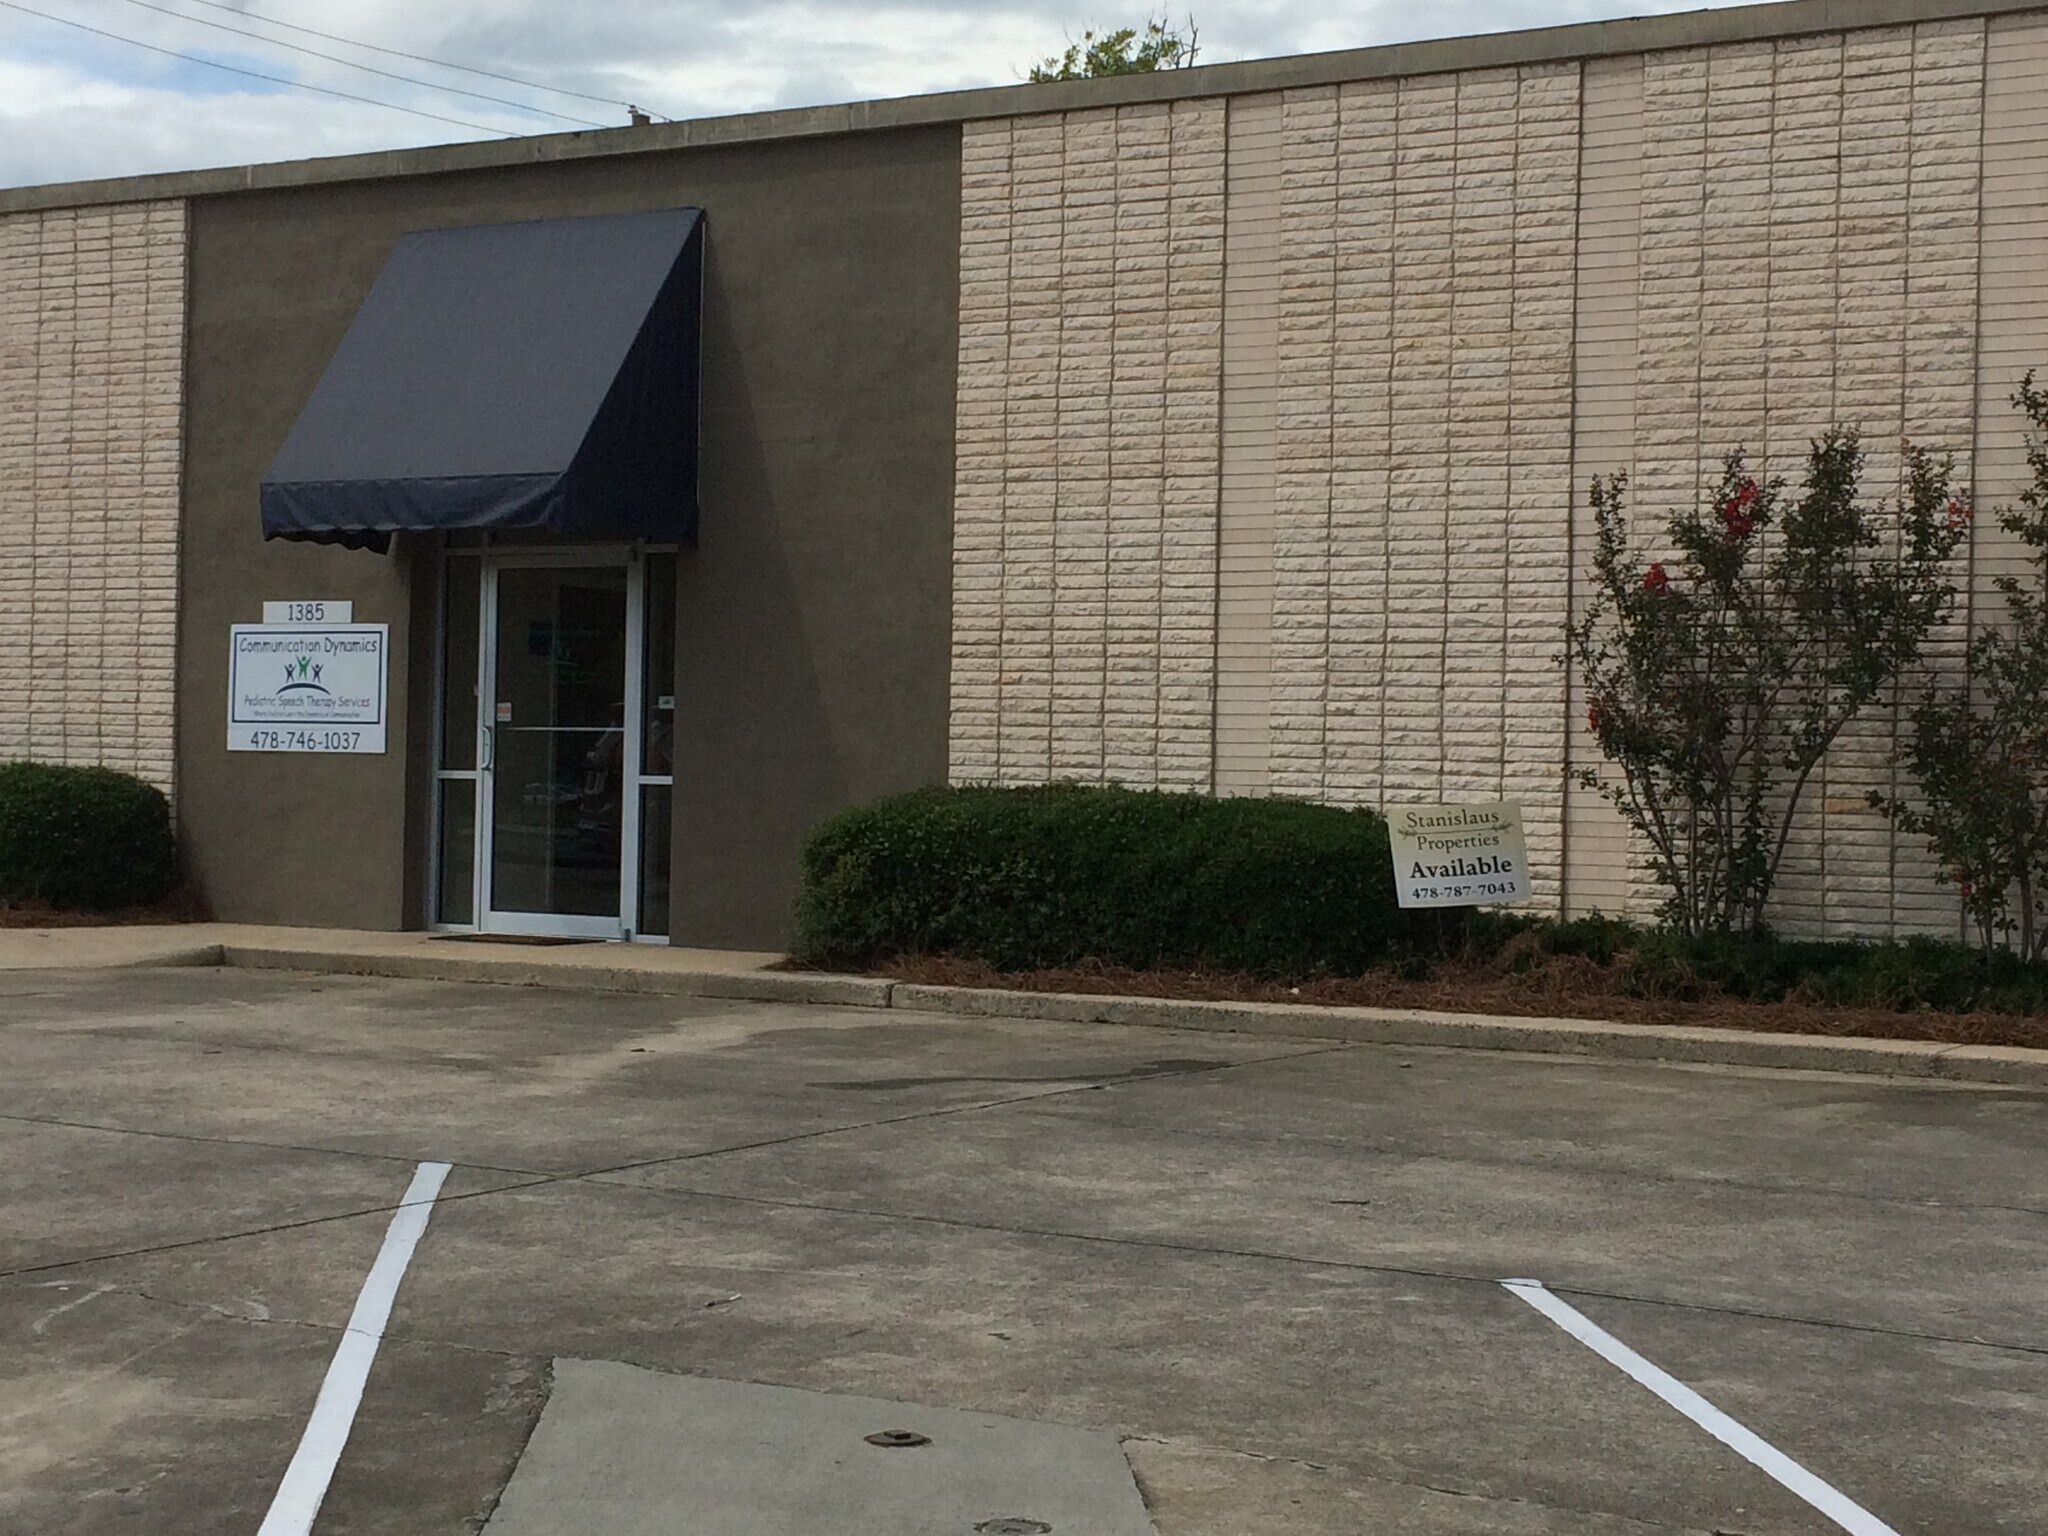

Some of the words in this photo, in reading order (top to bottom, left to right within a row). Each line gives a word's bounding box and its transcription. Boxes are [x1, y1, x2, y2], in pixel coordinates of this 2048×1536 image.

[288, 603, 324, 621] 1385
[240, 638, 320, 653] Communication
[324, 637, 377, 656] Dynamics
[279, 695, 304, 710] Speech
[306, 695, 336, 711] Therapy
[339, 696, 370, 708] Services
[250, 731, 360, 750] 478-746-1037
[1406, 809, 1499, 828] Stanislaus
[1417, 834, 1500, 854] Properties
[1410, 855, 1512, 879] Available
[1412, 882, 1516, 899] 478-787-7043
